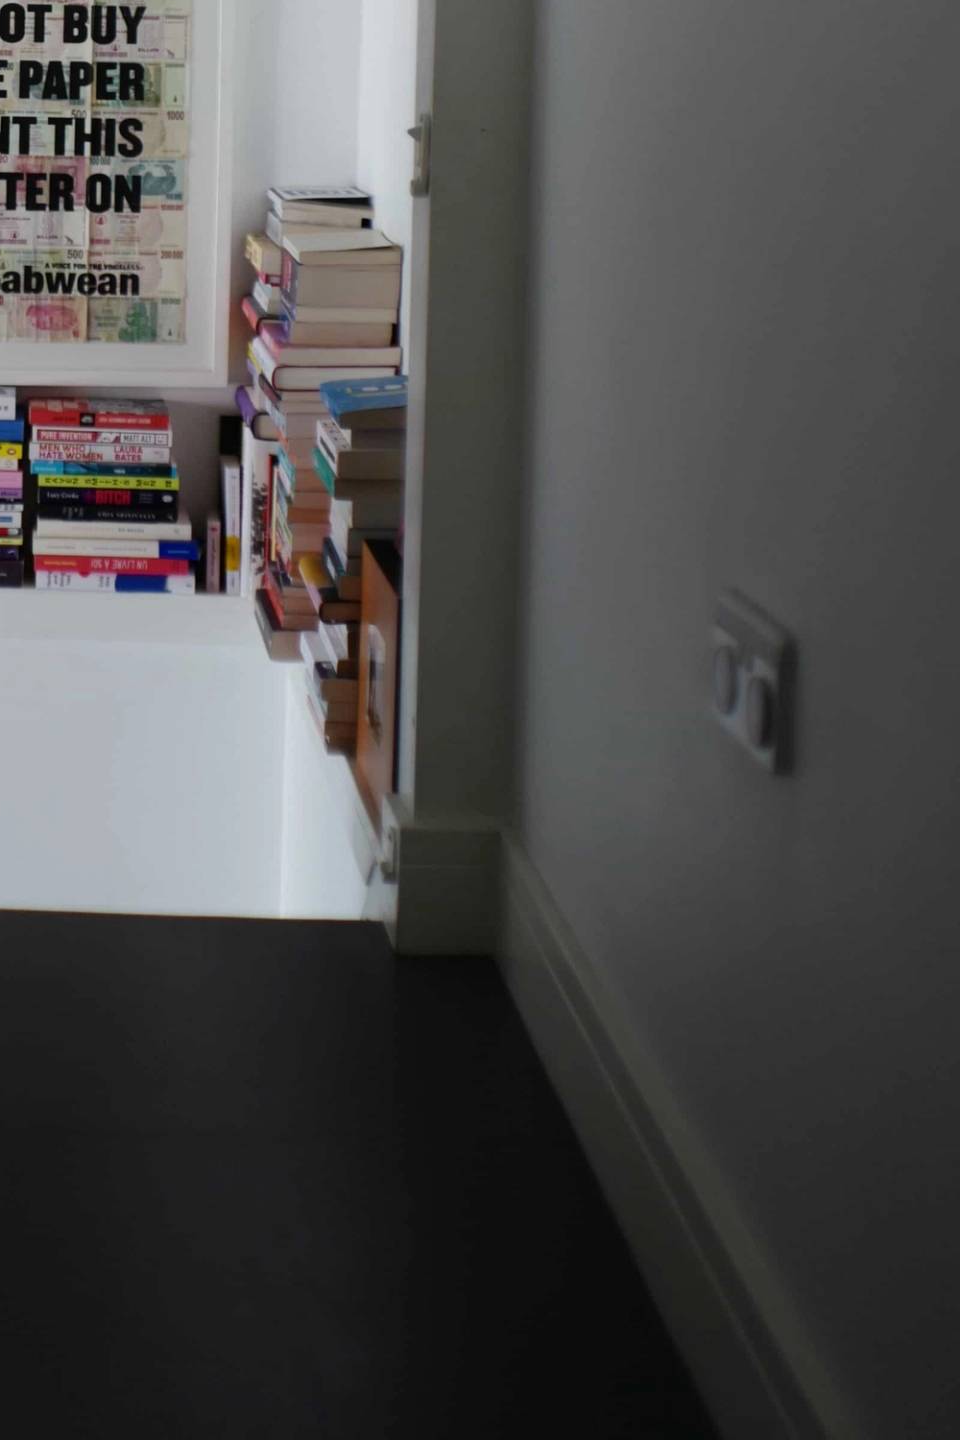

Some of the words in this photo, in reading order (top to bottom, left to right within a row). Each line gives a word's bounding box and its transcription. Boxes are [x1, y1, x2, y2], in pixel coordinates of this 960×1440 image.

[64, 5, 146, 44] BUY
[19, 61, 145, 101] PAPER
[48, 118, 143, 158] THIS
[86, 174, 142, 213] ON
[40, 444, 60, 452] MEN
[62, 444, 86, 452] WHO
[114, 445, 144, 454] LAURA
[40, 452, 65, 460] HATE
[66, 452, 104, 461] WOMEN
[114, 454, 143, 462] BATES
[95, 490, 132, 506] BITCH
